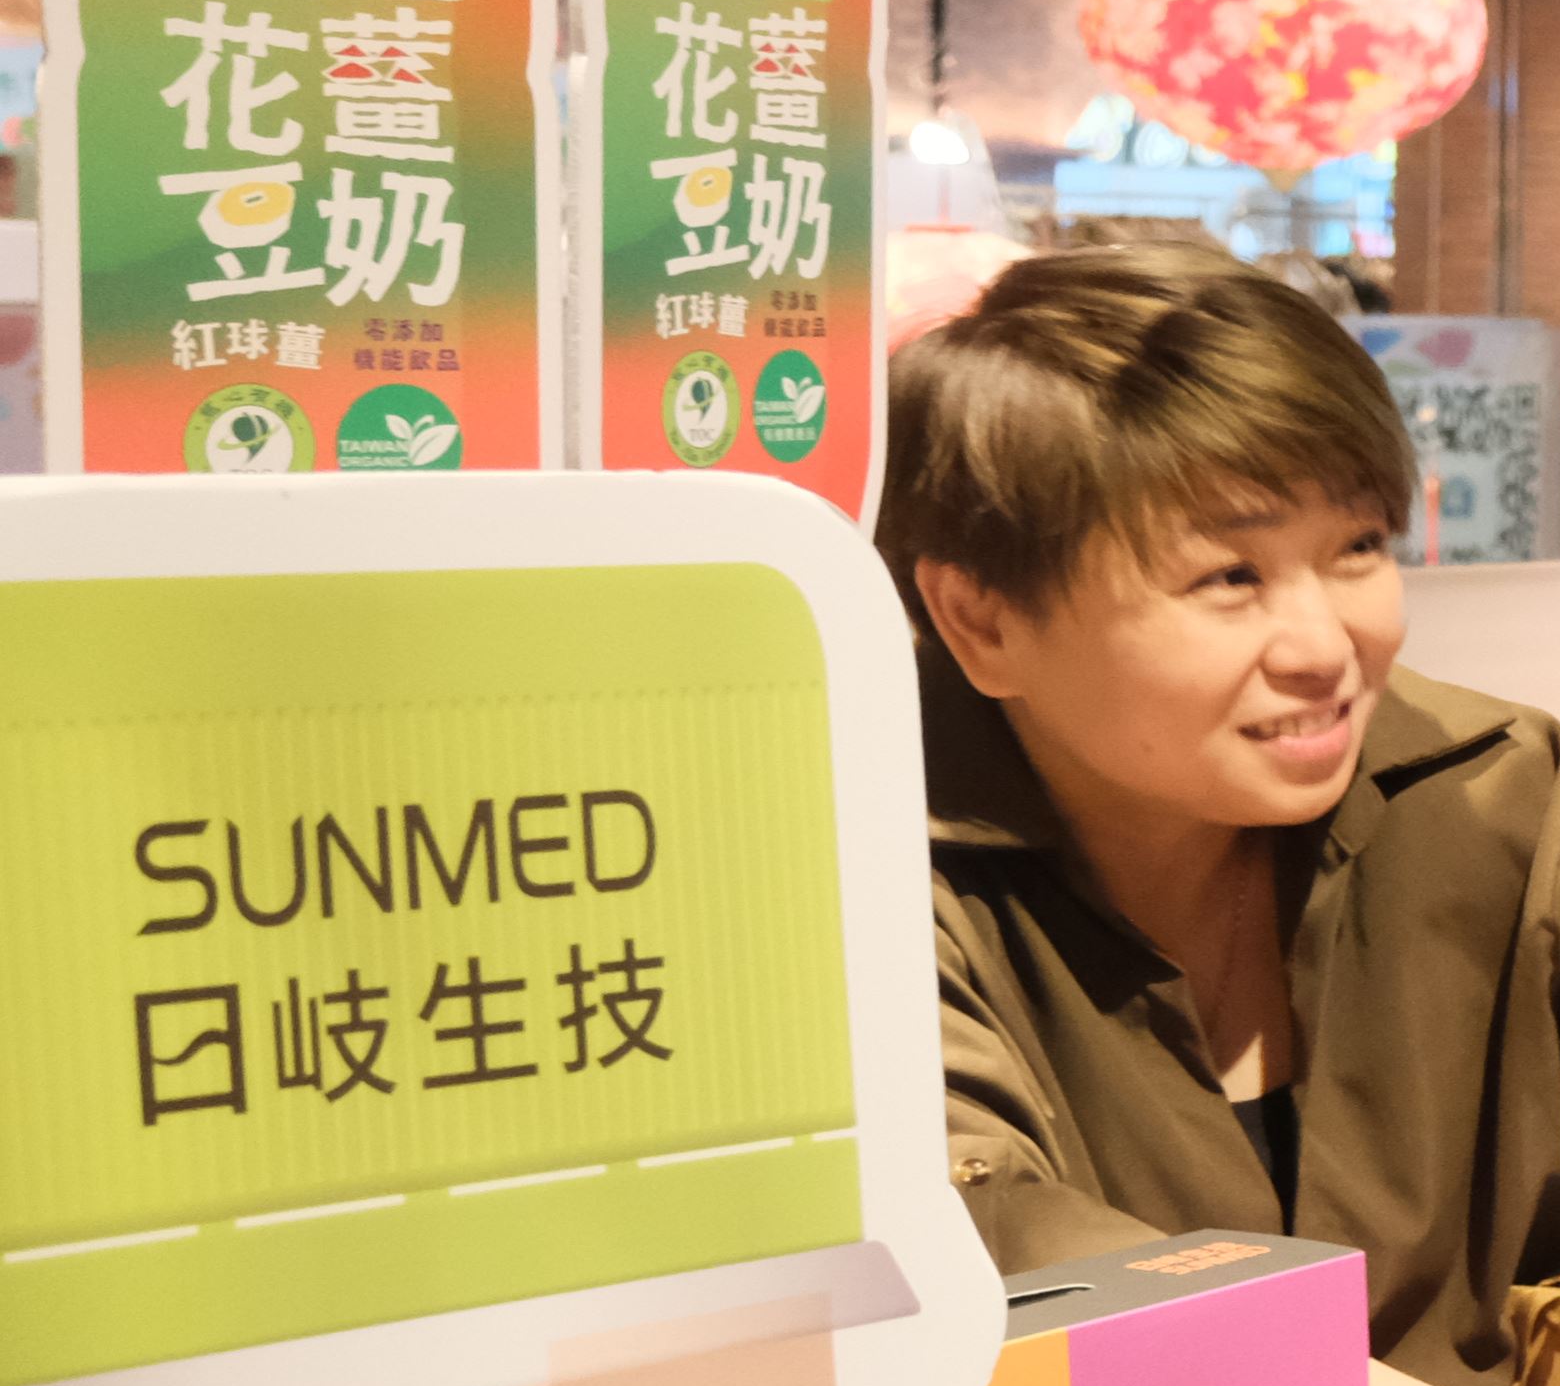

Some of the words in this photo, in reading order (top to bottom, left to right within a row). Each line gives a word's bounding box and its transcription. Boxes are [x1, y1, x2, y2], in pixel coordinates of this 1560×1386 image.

[159, 0, 455, 164] 花薑
[652, 1, 828, 149] 花薑
[158, 161, 465, 307] 豆奶
[650, 148, 832, 280] 豆奶
[171, 318, 326, 370] 紅球薑
[365, 318, 443, 342] 零添加
[655, 291, 749, 340] 紅球薑
[135, 788, 657, 937] SUNMED
[134, 937, 674, 1127] 日岐生技
